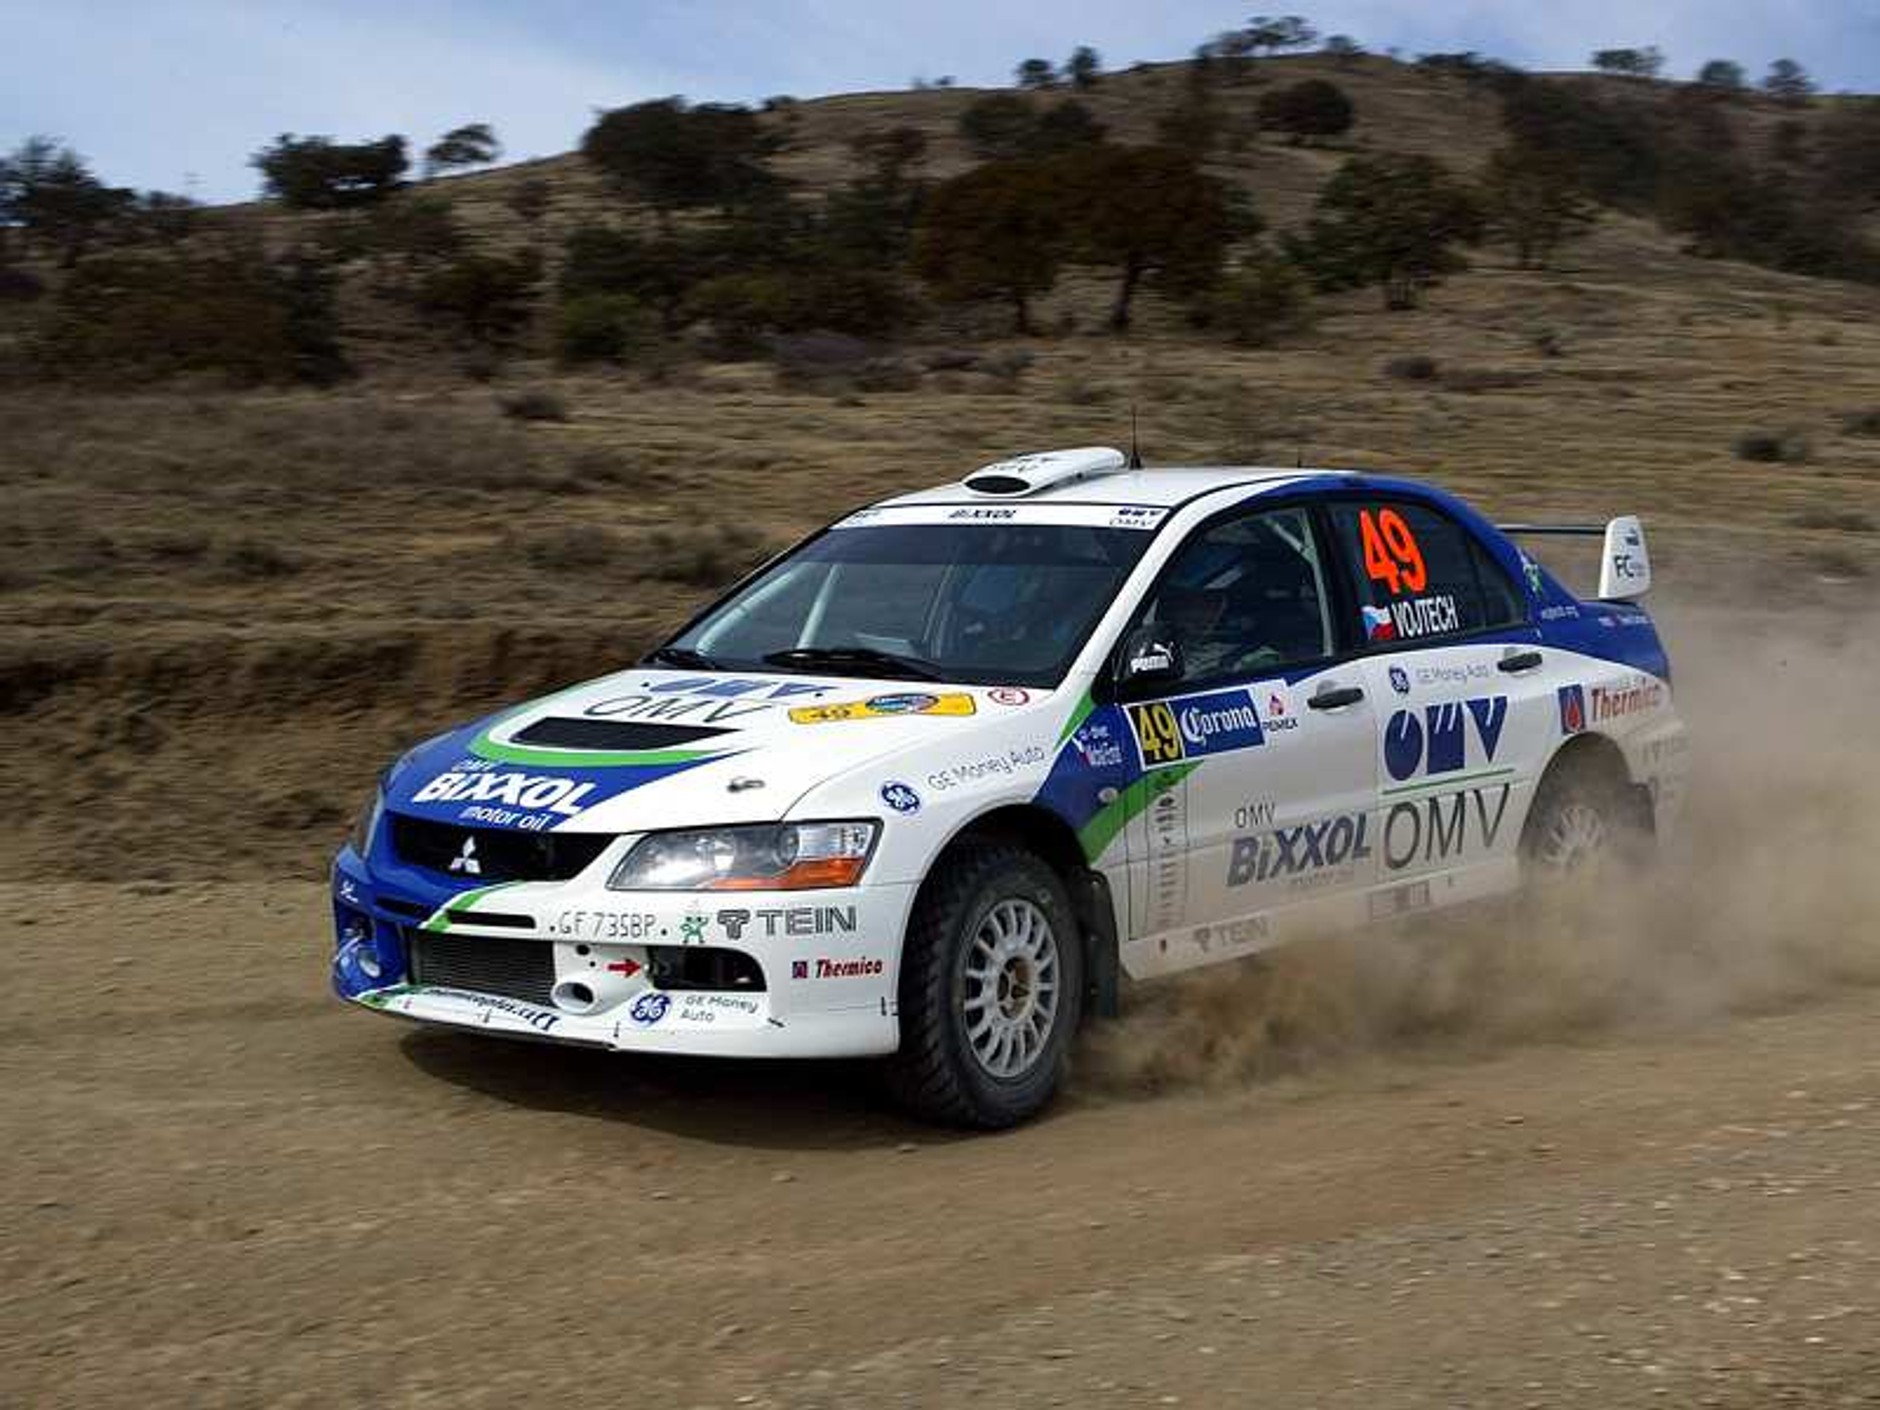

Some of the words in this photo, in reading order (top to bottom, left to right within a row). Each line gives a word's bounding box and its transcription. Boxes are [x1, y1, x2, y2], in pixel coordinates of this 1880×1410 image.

[1360, 509, 1427, 593] 49
[1391, 596, 1459, 637] VOJTECH
[584, 696, 772, 723] OMV
[1139, 705, 1181, 760] 49
[1180, 704, 1257, 744] Corona
[953, 757, 1012, 778] Money
[459, 807, 520, 825] motor
[518, 813, 552, 831] oil
[1235, 803, 1275, 828] OMV
[1385, 783, 1510, 870] OMV
[560, 912, 587, 934] GF
[757, 906, 857, 936] TEIN
[816, 956, 882, 978] Thermico
[681, 1009, 714, 1022] Auto
[708, 995, 759, 1014] Money
